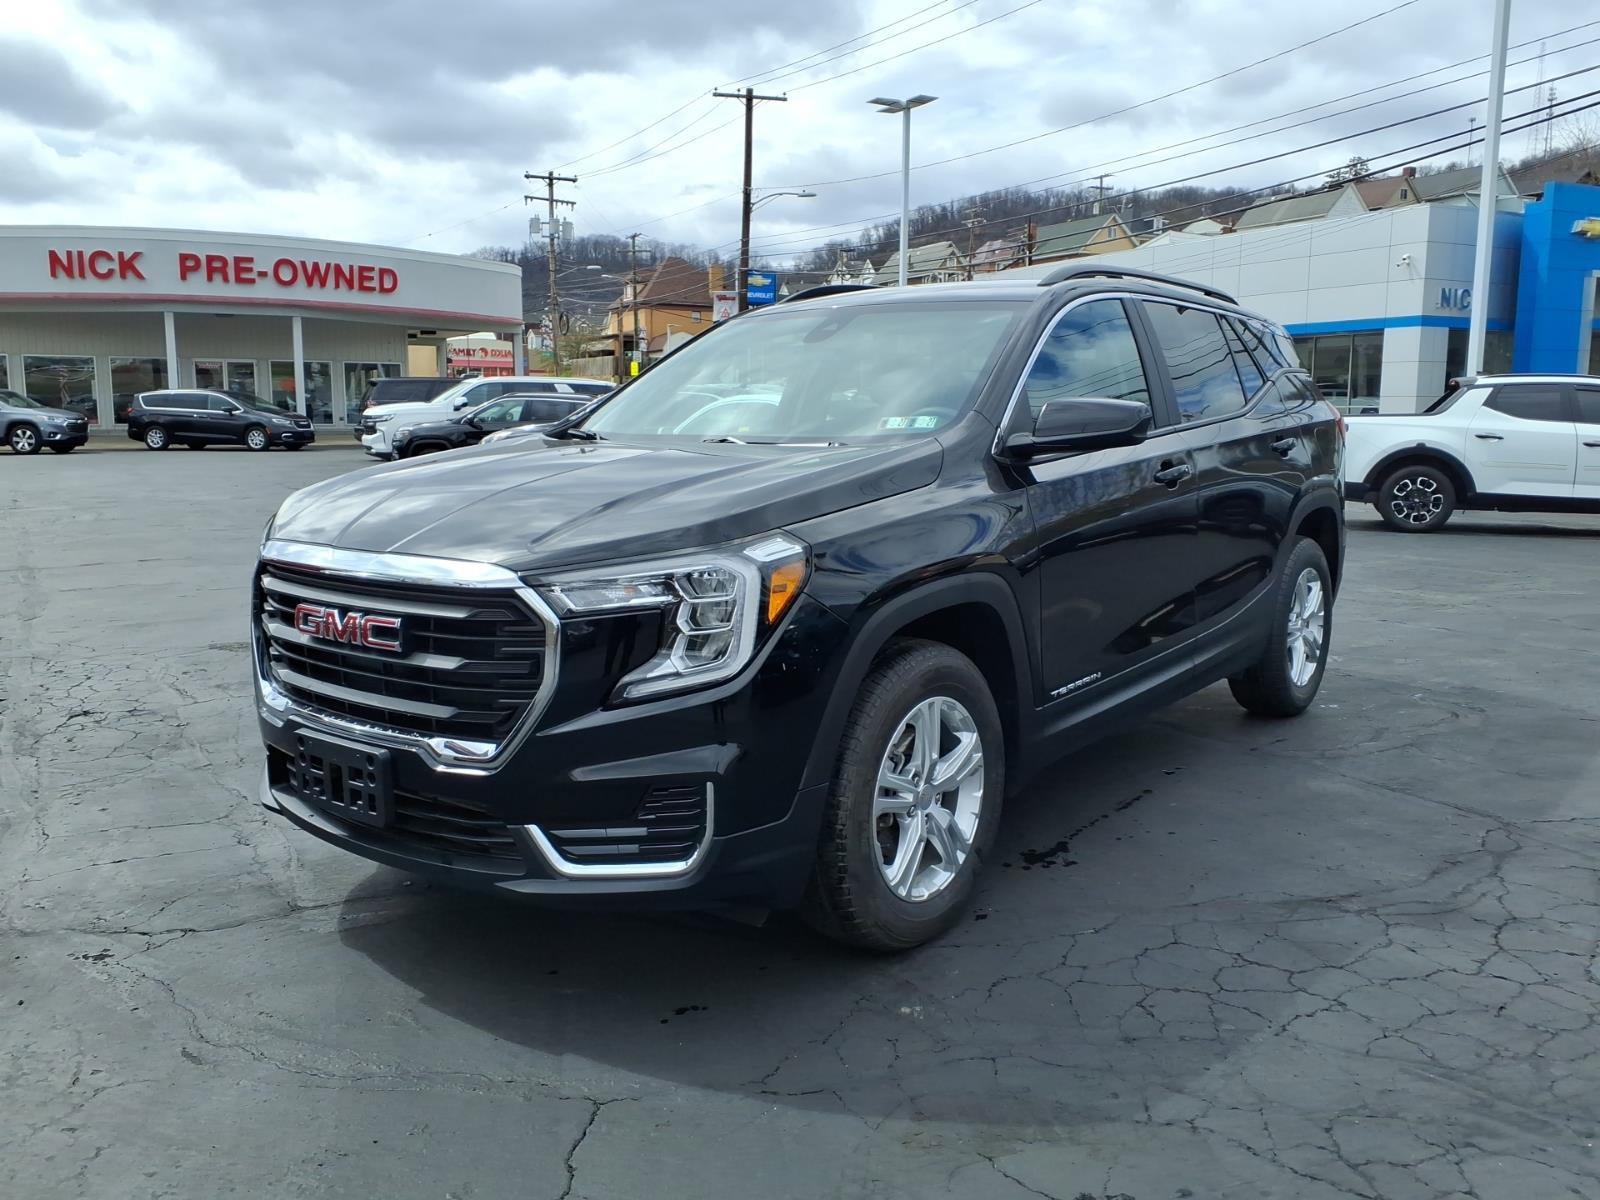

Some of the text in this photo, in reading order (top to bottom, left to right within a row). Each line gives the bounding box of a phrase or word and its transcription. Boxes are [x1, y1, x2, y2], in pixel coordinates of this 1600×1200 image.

[48, 250, 399, 294] NICK PRE-OWNED
[1440, 287, 1472, 309] NIC
[294, 603, 402, 653] GMC
[1050, 671, 1102, 698] TERRAIN
